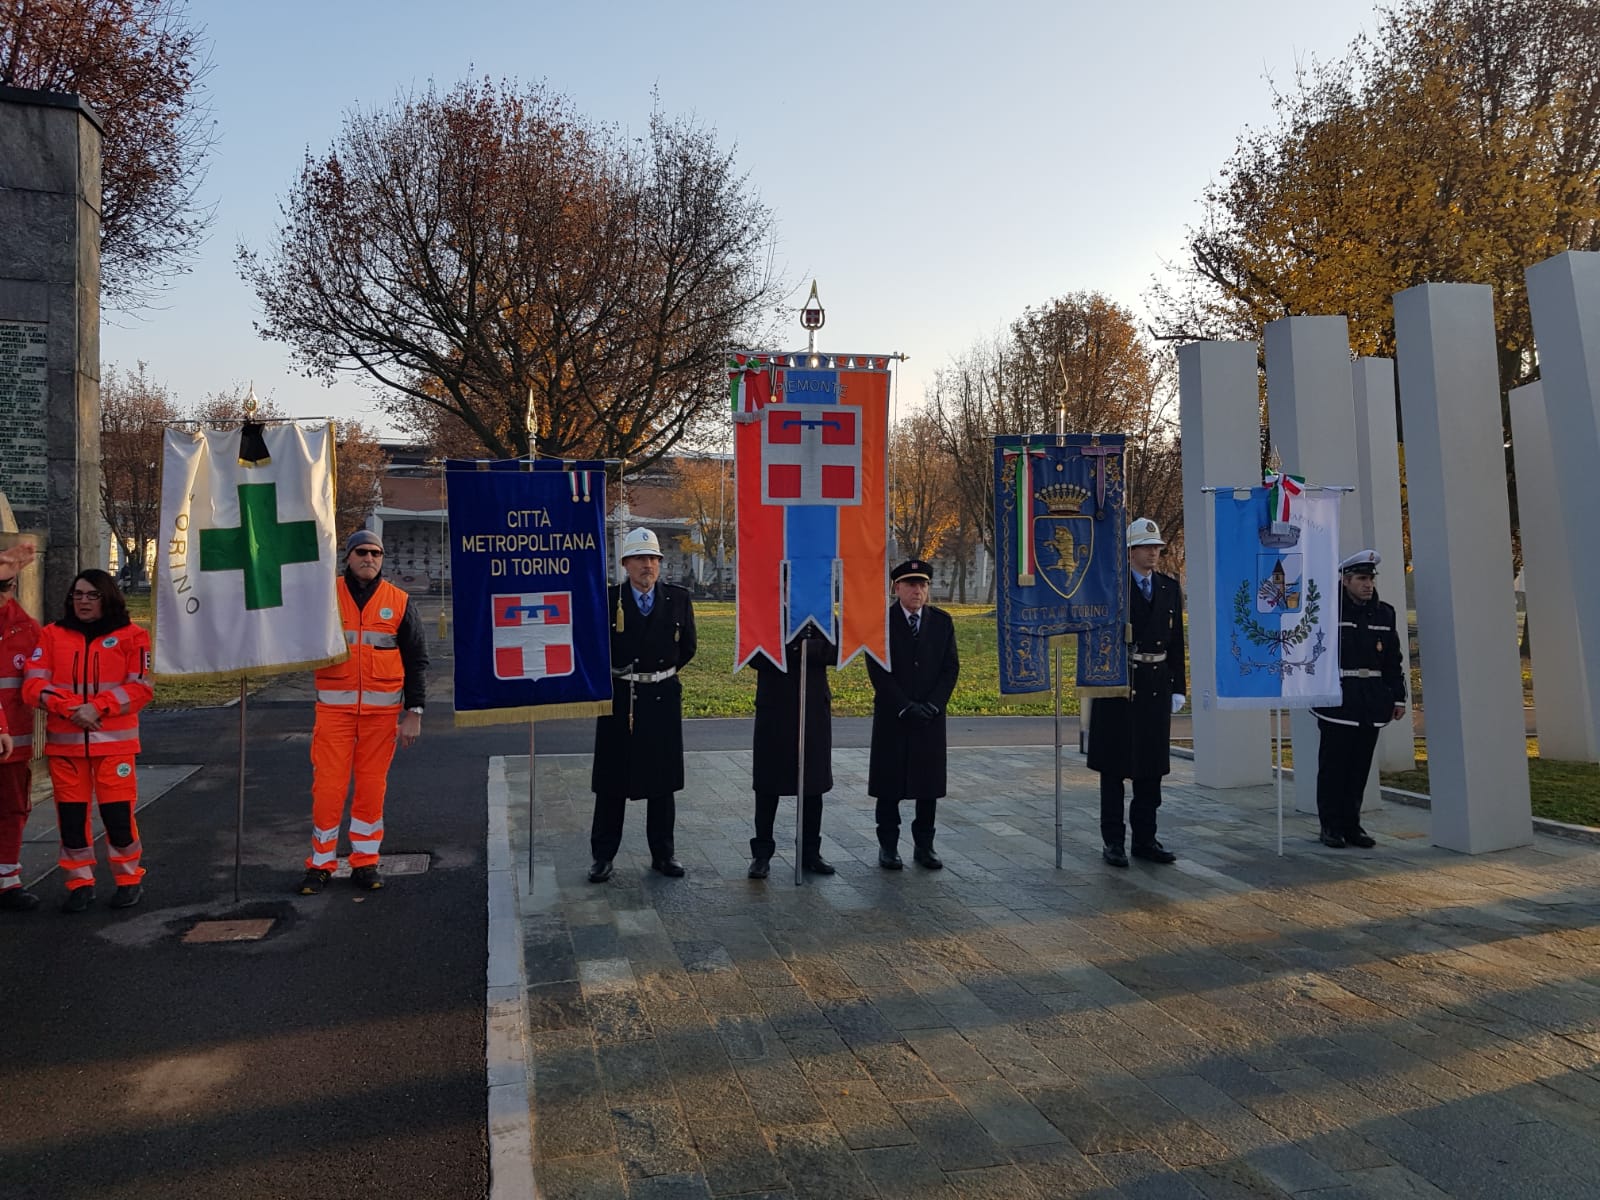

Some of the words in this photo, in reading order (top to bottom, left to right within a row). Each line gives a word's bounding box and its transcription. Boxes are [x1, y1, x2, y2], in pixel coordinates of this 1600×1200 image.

[775, 379, 849, 399] PIEMONTE
[507, 506, 552, 528] CITTÀ
[462, 532, 596, 553] METROPOLITANA
[491, 558, 507, 576] DI
[512, 557, 570, 575] TORINO
[1071, 604, 1109, 618] TORINO
